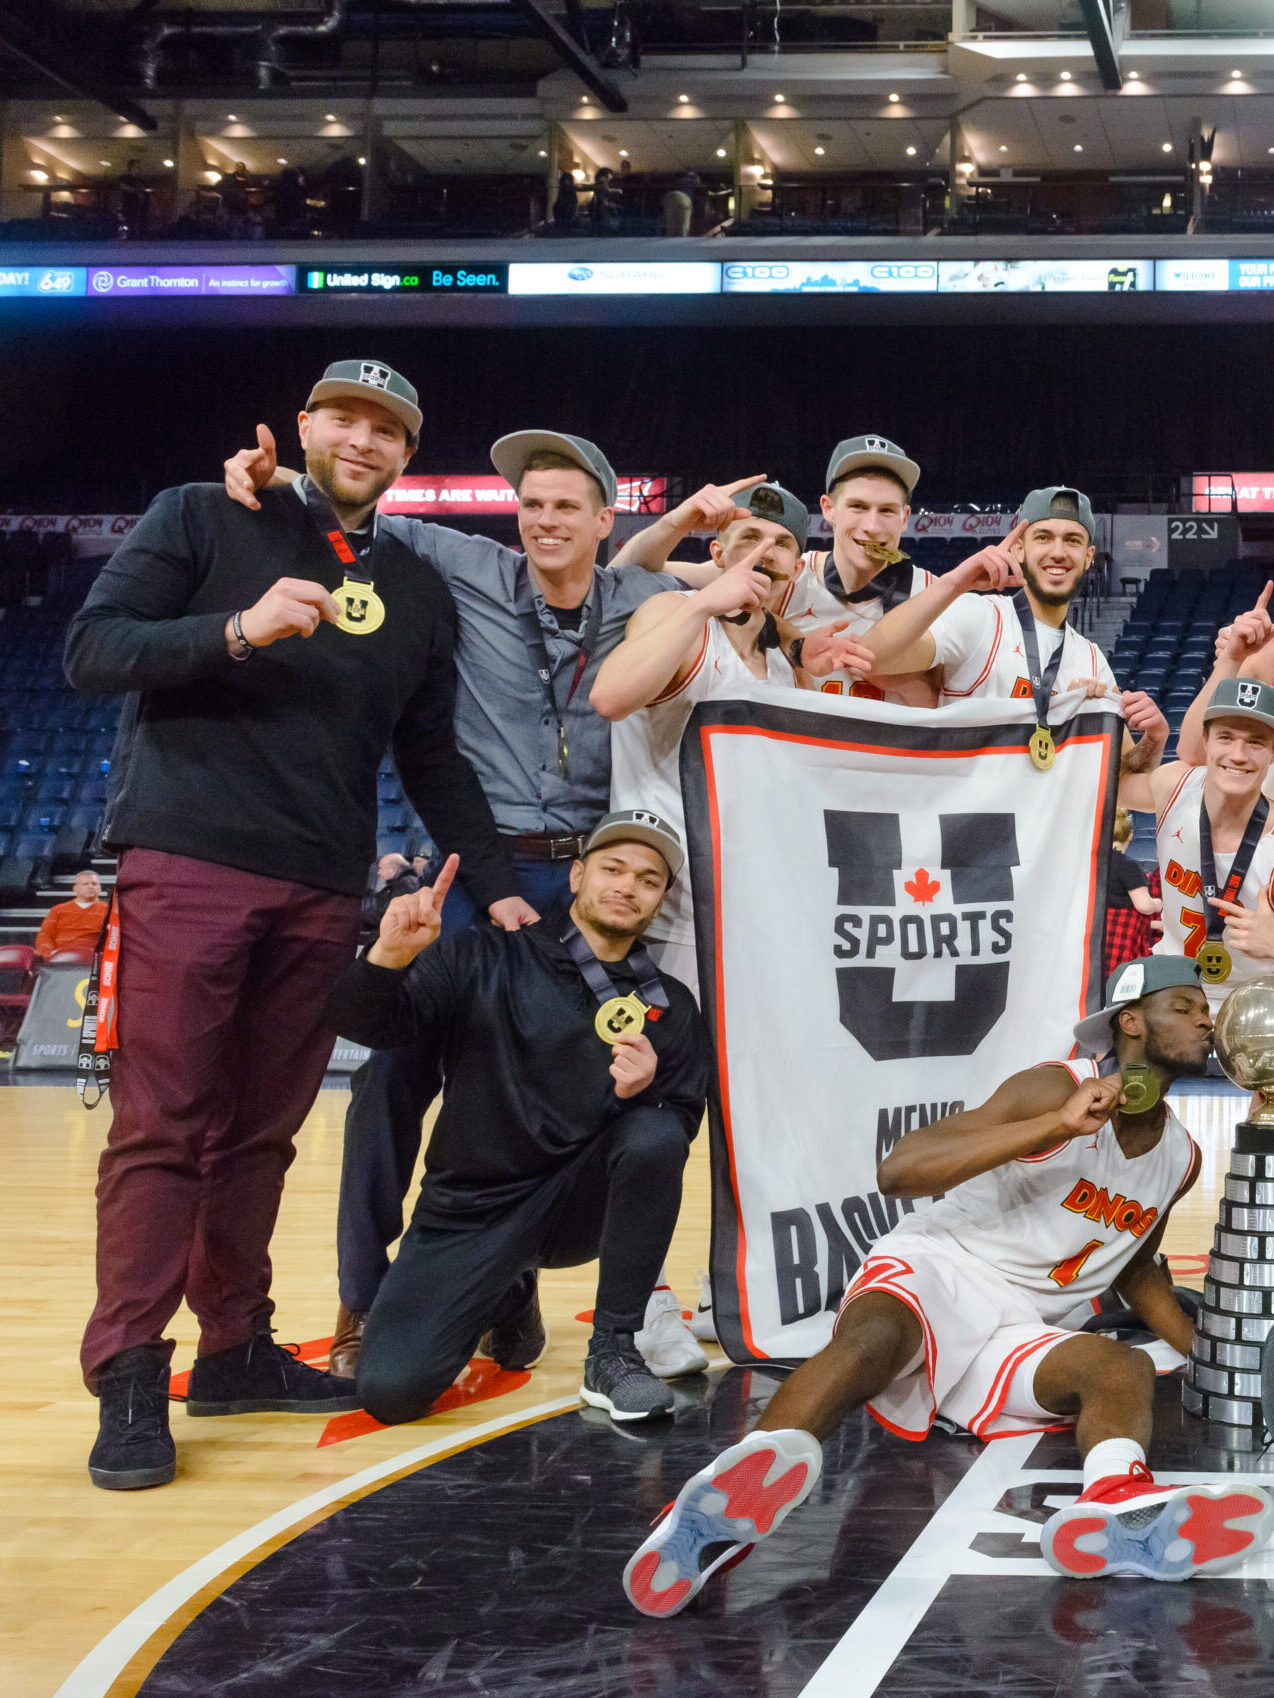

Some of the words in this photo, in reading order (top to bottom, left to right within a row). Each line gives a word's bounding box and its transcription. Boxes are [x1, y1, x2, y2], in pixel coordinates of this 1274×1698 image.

[1239, 263, 1267, 275] YOUR
[117, 276, 147, 288] Grant
[149, 275, 199, 288] Thornton
[326, 273, 366, 287] United
[432, 270, 453, 286] Be
[457, 270, 499, 286] Seen.
[1239, 276, 1261, 287] OUR
[385, 488, 436, 502] TIMES
[437, 488, 474, 502] ARE
[475, 488, 520, 502] WAIT
[914, 514, 954, 532] Q104
[962, 513, 1002, 532] Q104
[1171, 521, 1198, 539] 22
[1238, 693, 1258, 701] SPORTS
[1164, 860, 1203, 900] DIN
[833, 909, 1014, 961] SPORTS
[103, 961, 114, 986] DINOS
[32, 1045, 69, 1057] SPORTS
[1062, 1177, 1158, 1239] DINOS
[1047, 1239, 1105, 1288] 1
